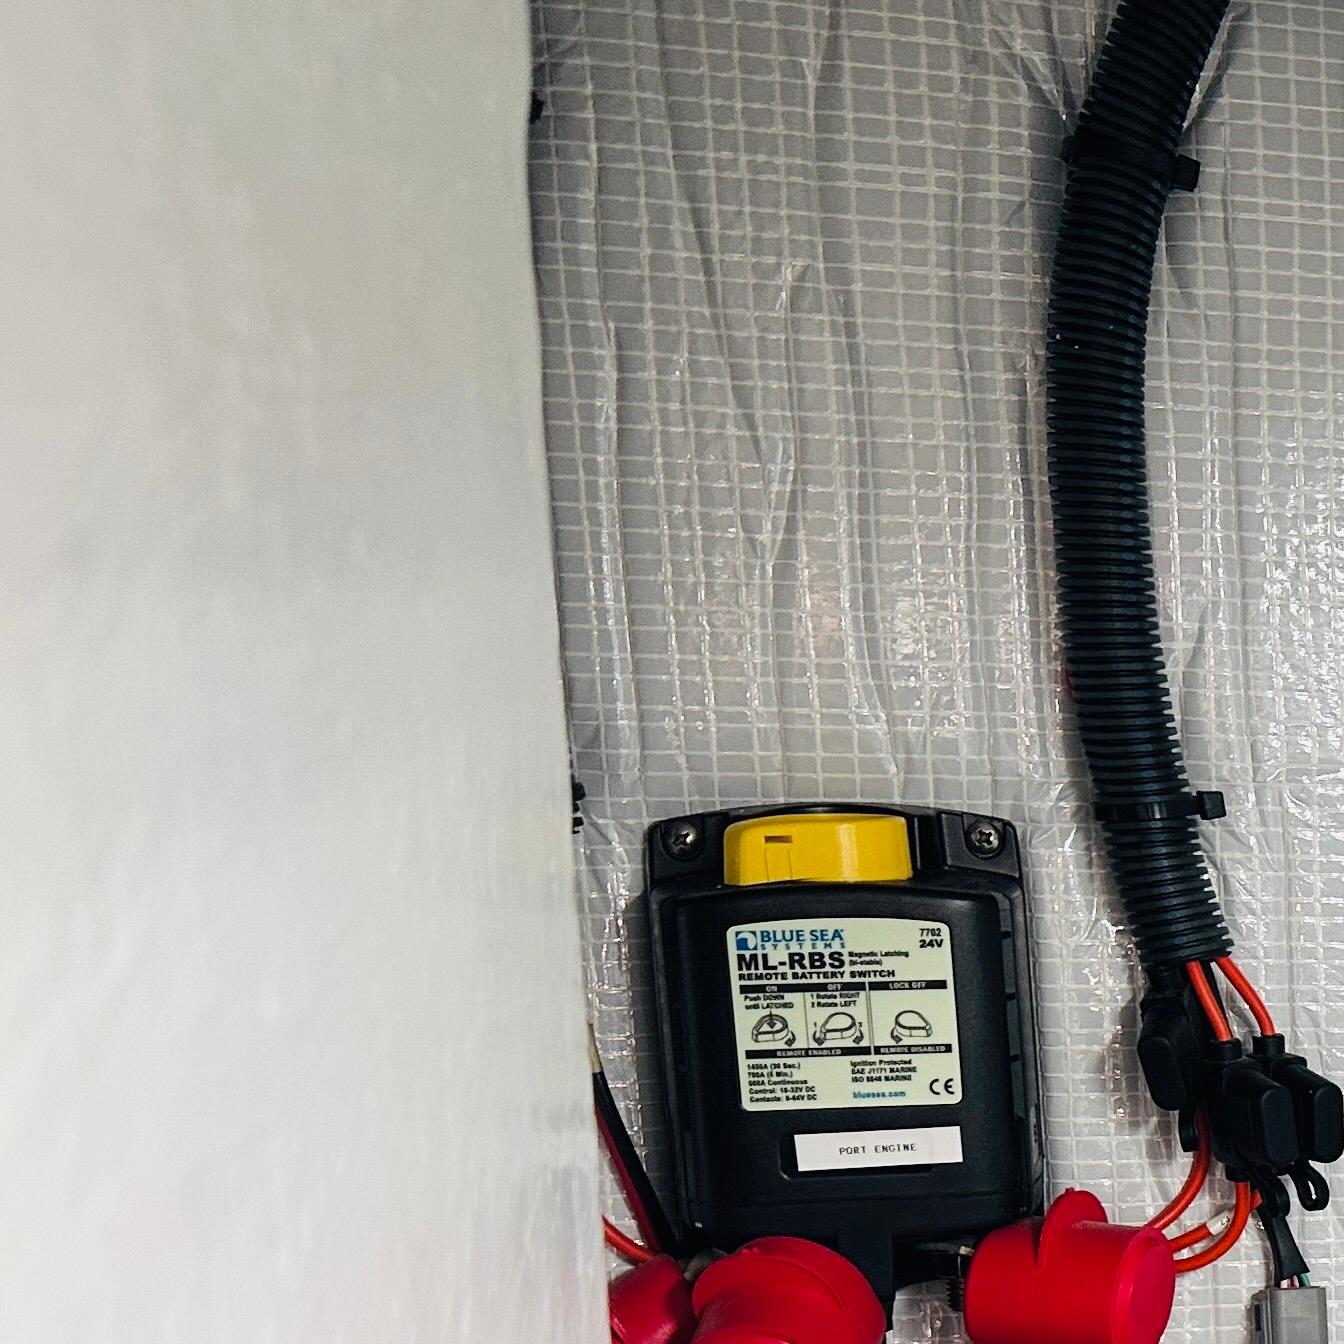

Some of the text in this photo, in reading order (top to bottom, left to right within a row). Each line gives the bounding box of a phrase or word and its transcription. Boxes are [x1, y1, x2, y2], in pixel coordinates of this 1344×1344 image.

[760, 929, 844, 943] BLUE SEA
[761, 942, 846, 951] SYSTEMS
[919, 939, 944, 949] 24V
[736, 951, 846, 971] ML-RBS
[738, 970, 896, 981] REMOTE BATTERY SWITCH
[929, 1078, 955, 1096] CE
[839, 1143, 917, 1156] PORT ENGINE
